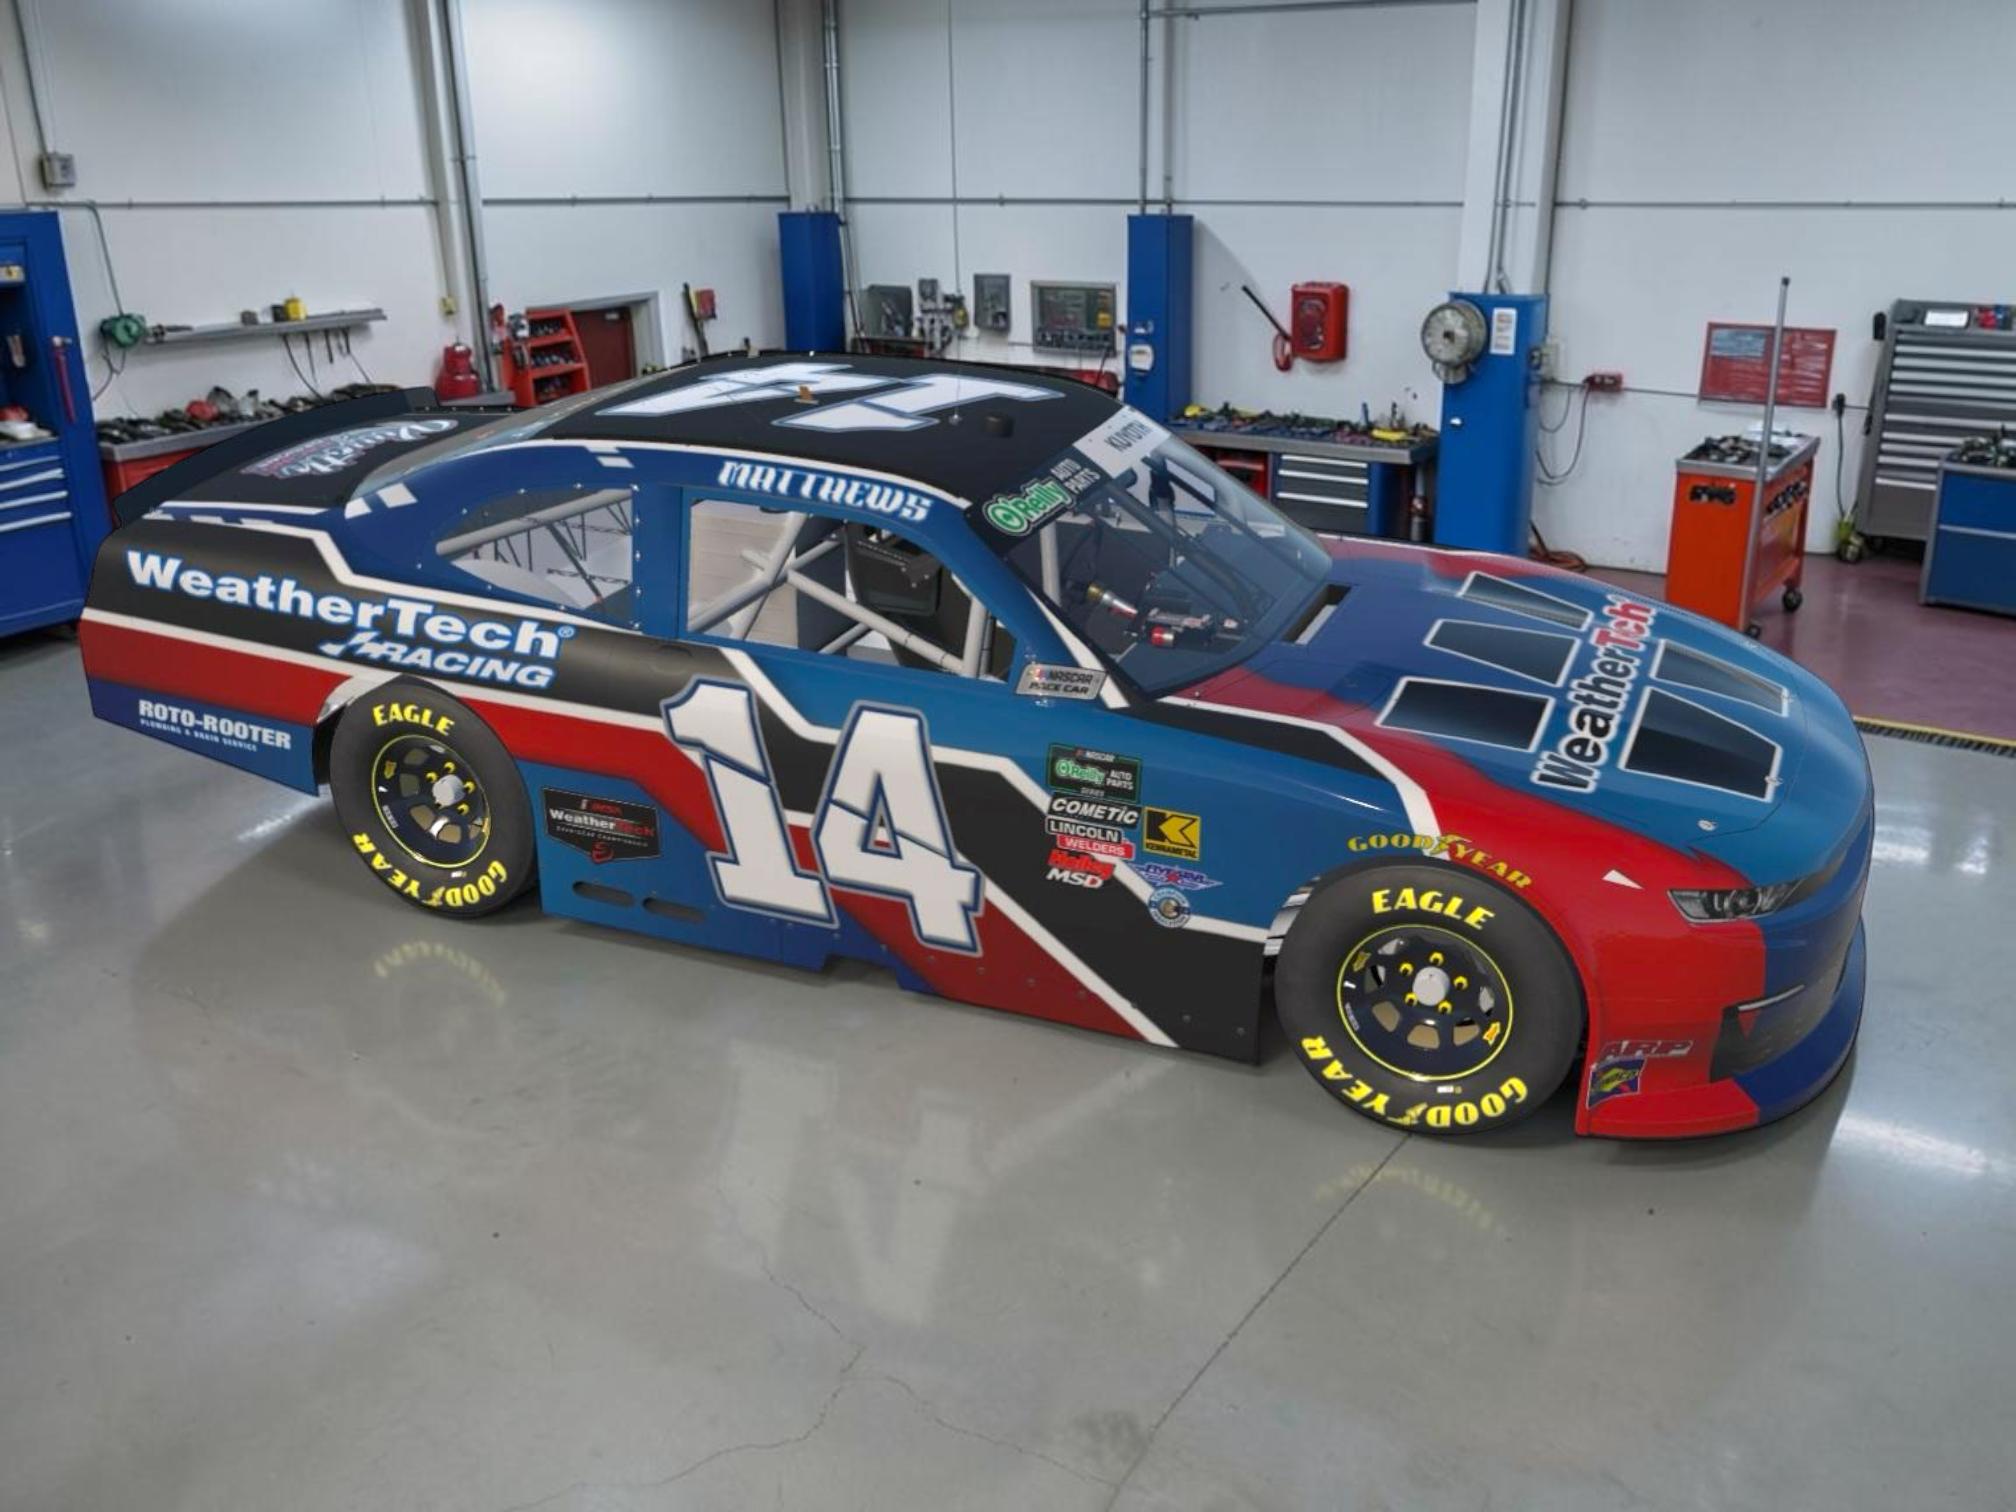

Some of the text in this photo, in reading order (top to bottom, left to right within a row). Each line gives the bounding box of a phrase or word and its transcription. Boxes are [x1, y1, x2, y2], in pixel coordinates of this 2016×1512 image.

[1050, 458, 1082, 480] AUTO
[1064, 467, 1100, 494] PARTS
[717, 460, 934, 522] MATTHEWS
[985, 477, 1073, 534] O'Reilly
[382, 641, 554, 688] RACING
[1063, 684, 1089, 694] CAR
[138, 699, 292, 749] ROTO-ROOTER
[372, 702, 455, 736] EAGLE
[660, 672, 986, 957] 14
[1052, 798, 1139, 824] COMETIC
[1050, 820, 1119, 843] LINCOLN
[1063, 837, 1126, 857] WELDERS
[1046, 868, 1103, 889] MSD
[1371, 887, 1496, 931] EAGLE
